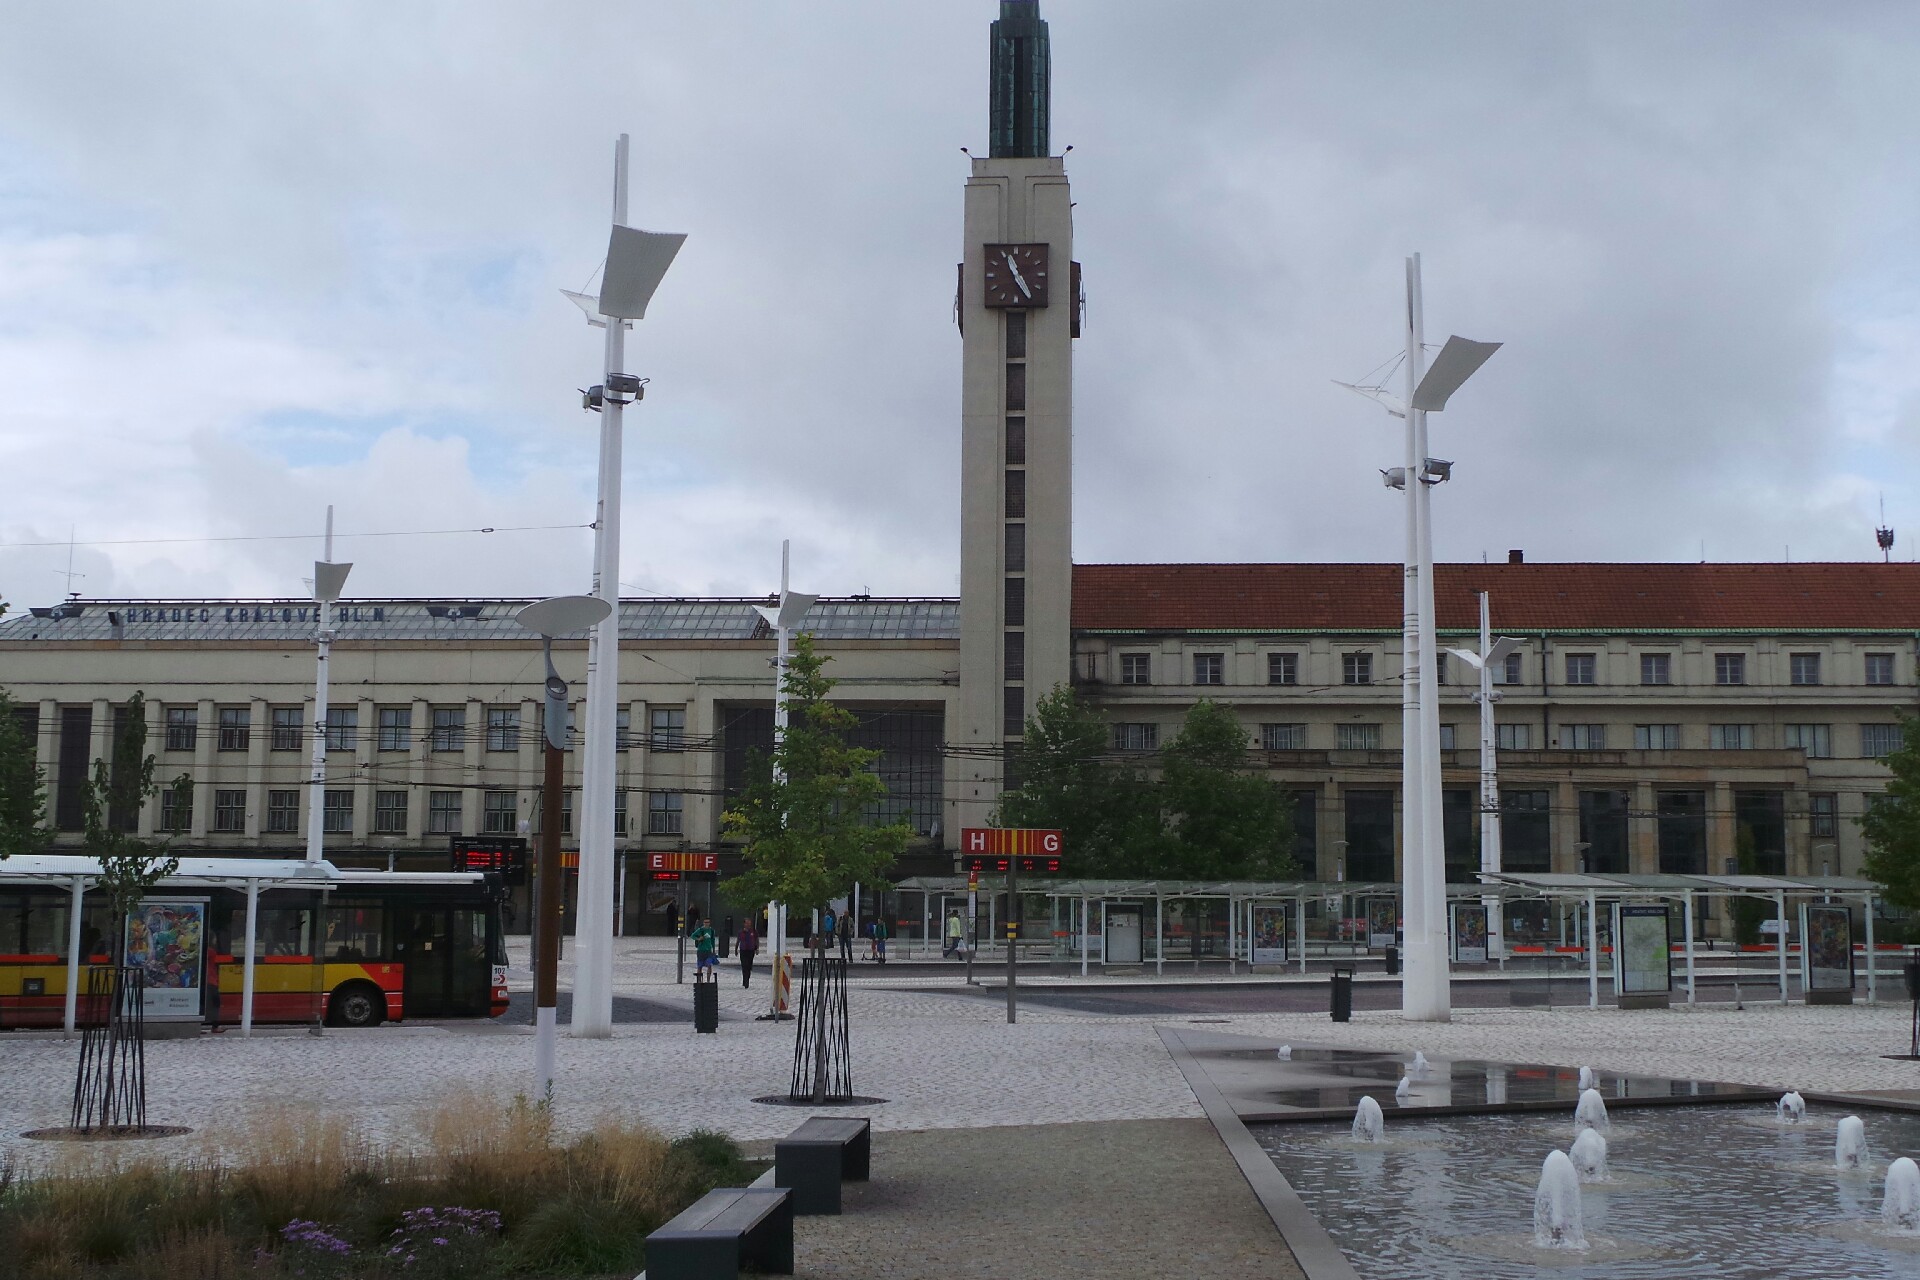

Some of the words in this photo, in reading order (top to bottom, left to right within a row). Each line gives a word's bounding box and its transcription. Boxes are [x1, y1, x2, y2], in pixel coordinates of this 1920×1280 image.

[127, 607, 209, 622] HRADEC
[970, 832, 985, 851] H
[1043, 834, 1058, 851] G
[652, 855, 663, 868] E
[705, 856, 714, 869] F
[494, 967, 506, 975] 102
